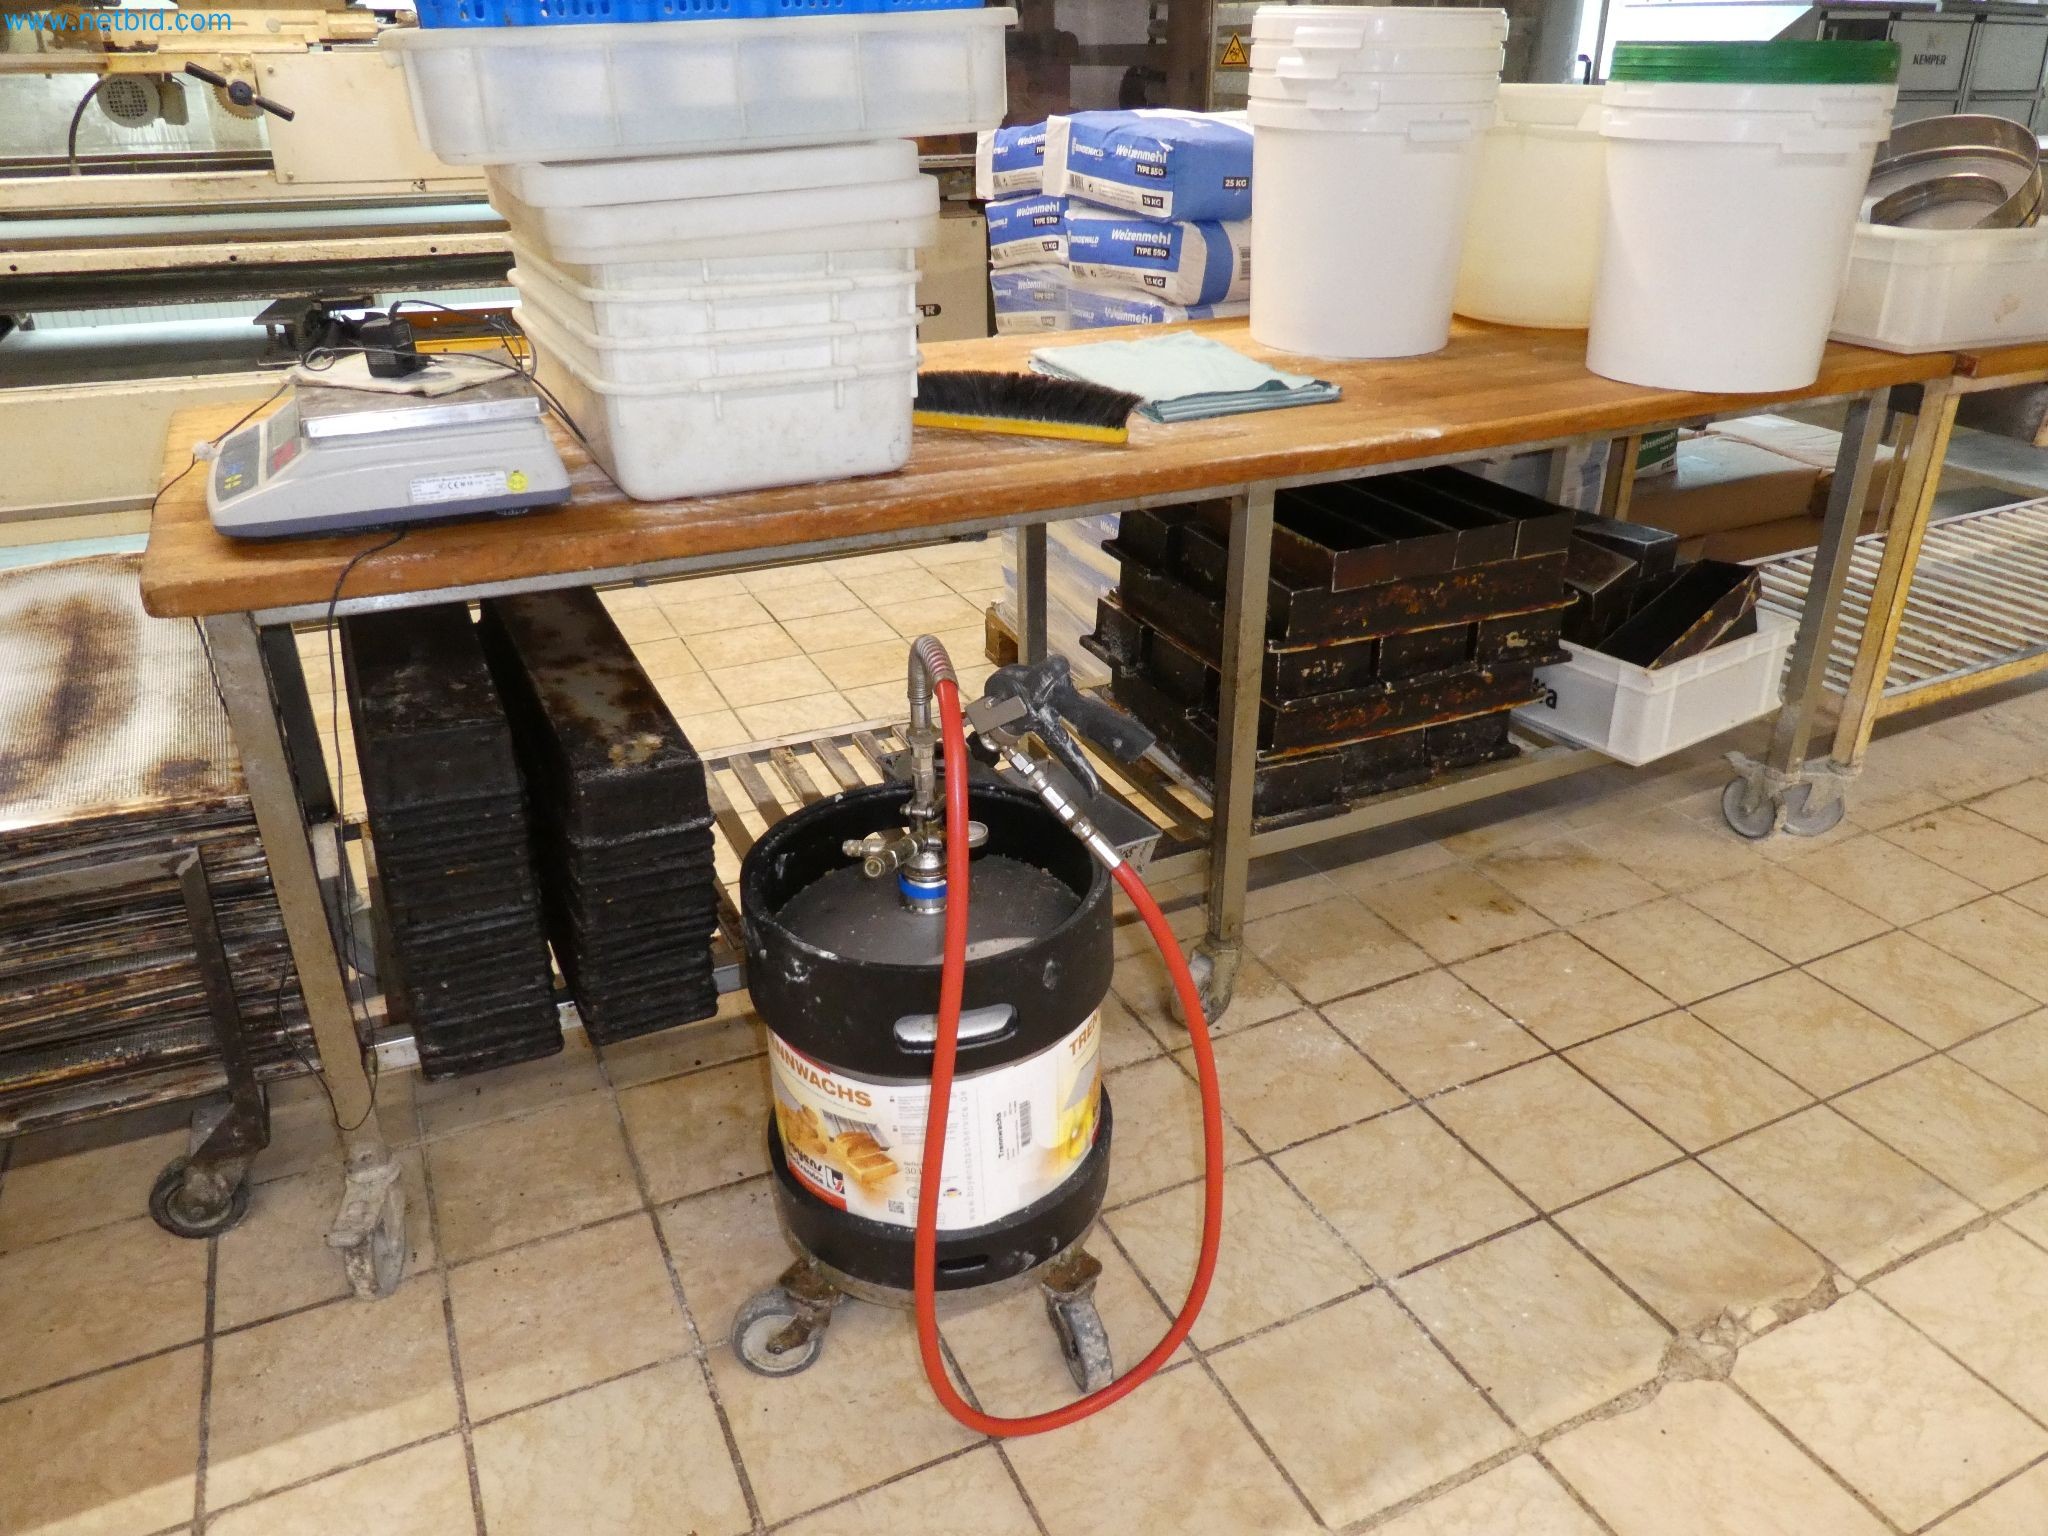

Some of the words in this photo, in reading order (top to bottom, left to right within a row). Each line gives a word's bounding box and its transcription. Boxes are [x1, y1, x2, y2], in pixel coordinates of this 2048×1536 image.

[1912, 53, 1947, 65] KEMPER
[1115, 143, 1167, 164] Weizenmehl
[1136, 164, 1151, 175] TYPE
[1225, 179, 1236, 187] 25
[1235, 179, 1247, 187] KG
[1151, 198, 1161, 207] KG
[1111, 228, 1172, 245] Weizenmehl
[1136, 246, 1151, 256] TYPE
[1152, 248, 1167, 257] 550
[1153, 278, 1163, 287] KG
